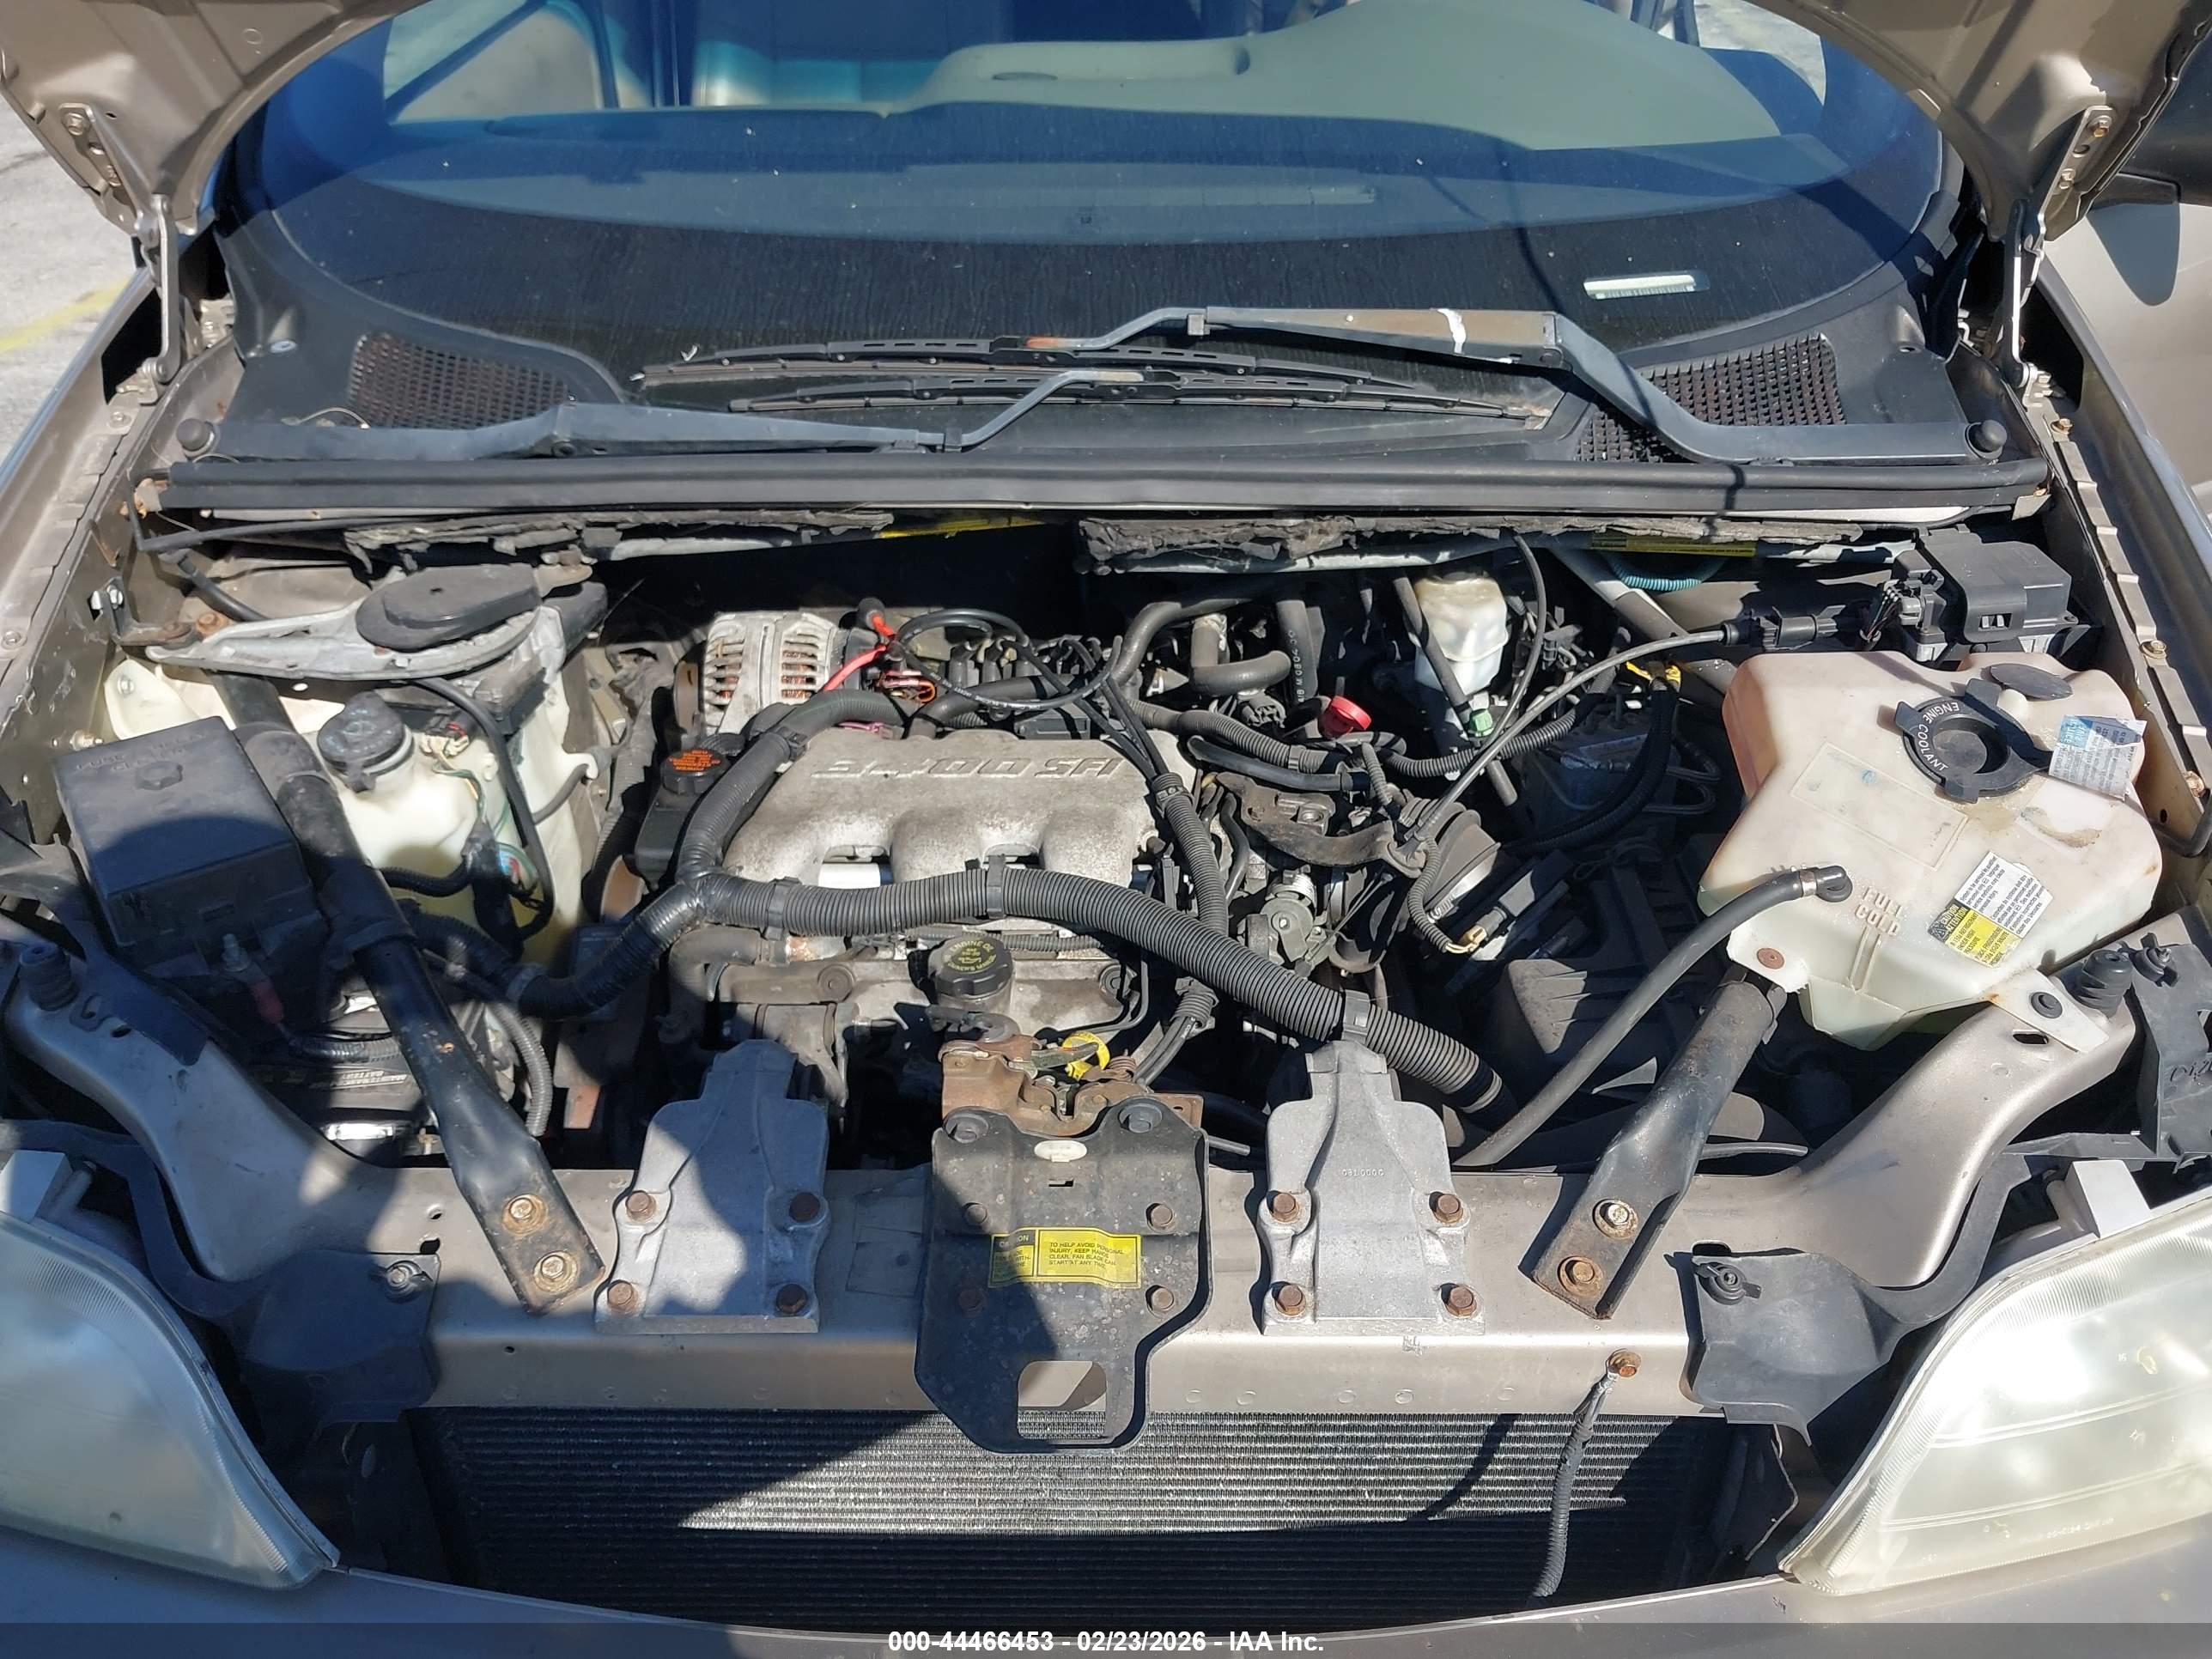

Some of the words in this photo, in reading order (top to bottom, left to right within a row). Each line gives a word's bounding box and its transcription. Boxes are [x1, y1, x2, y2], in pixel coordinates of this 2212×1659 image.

[1922, 701, 1960, 724] ENGINE
[1917, 723, 1948, 771] COOLANT
[1033, 757, 1125, 779] SFI
[1862, 885, 1904, 919] FULL
[1855, 904, 1900, 936] COLD
[1940, 904, 1959, 925] CAUTION
[1946, 907, 1966, 931] ATTENTION
[999, 1235, 1030, 1248] CAION
